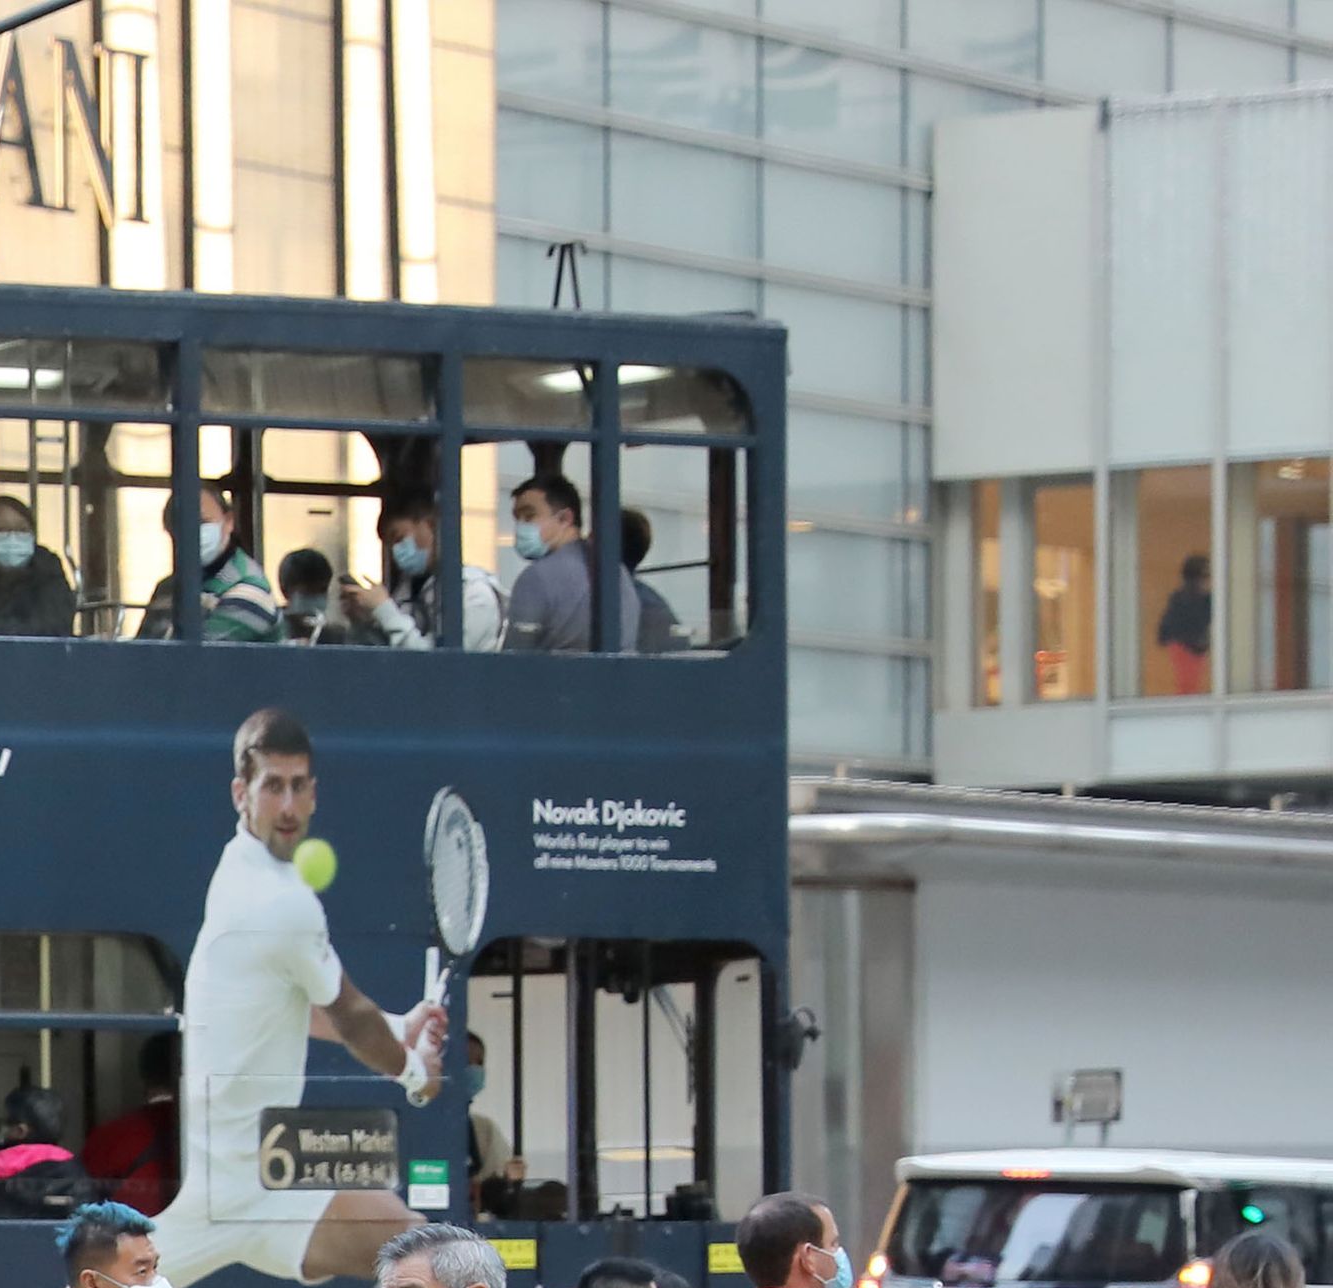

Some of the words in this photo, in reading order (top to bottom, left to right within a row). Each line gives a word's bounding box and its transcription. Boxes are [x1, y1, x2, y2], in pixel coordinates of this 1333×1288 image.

[533, 798, 599, 825] Novak
[601, 799, 686, 832] Djokovic
[260, 1122, 296, 1190] 6
